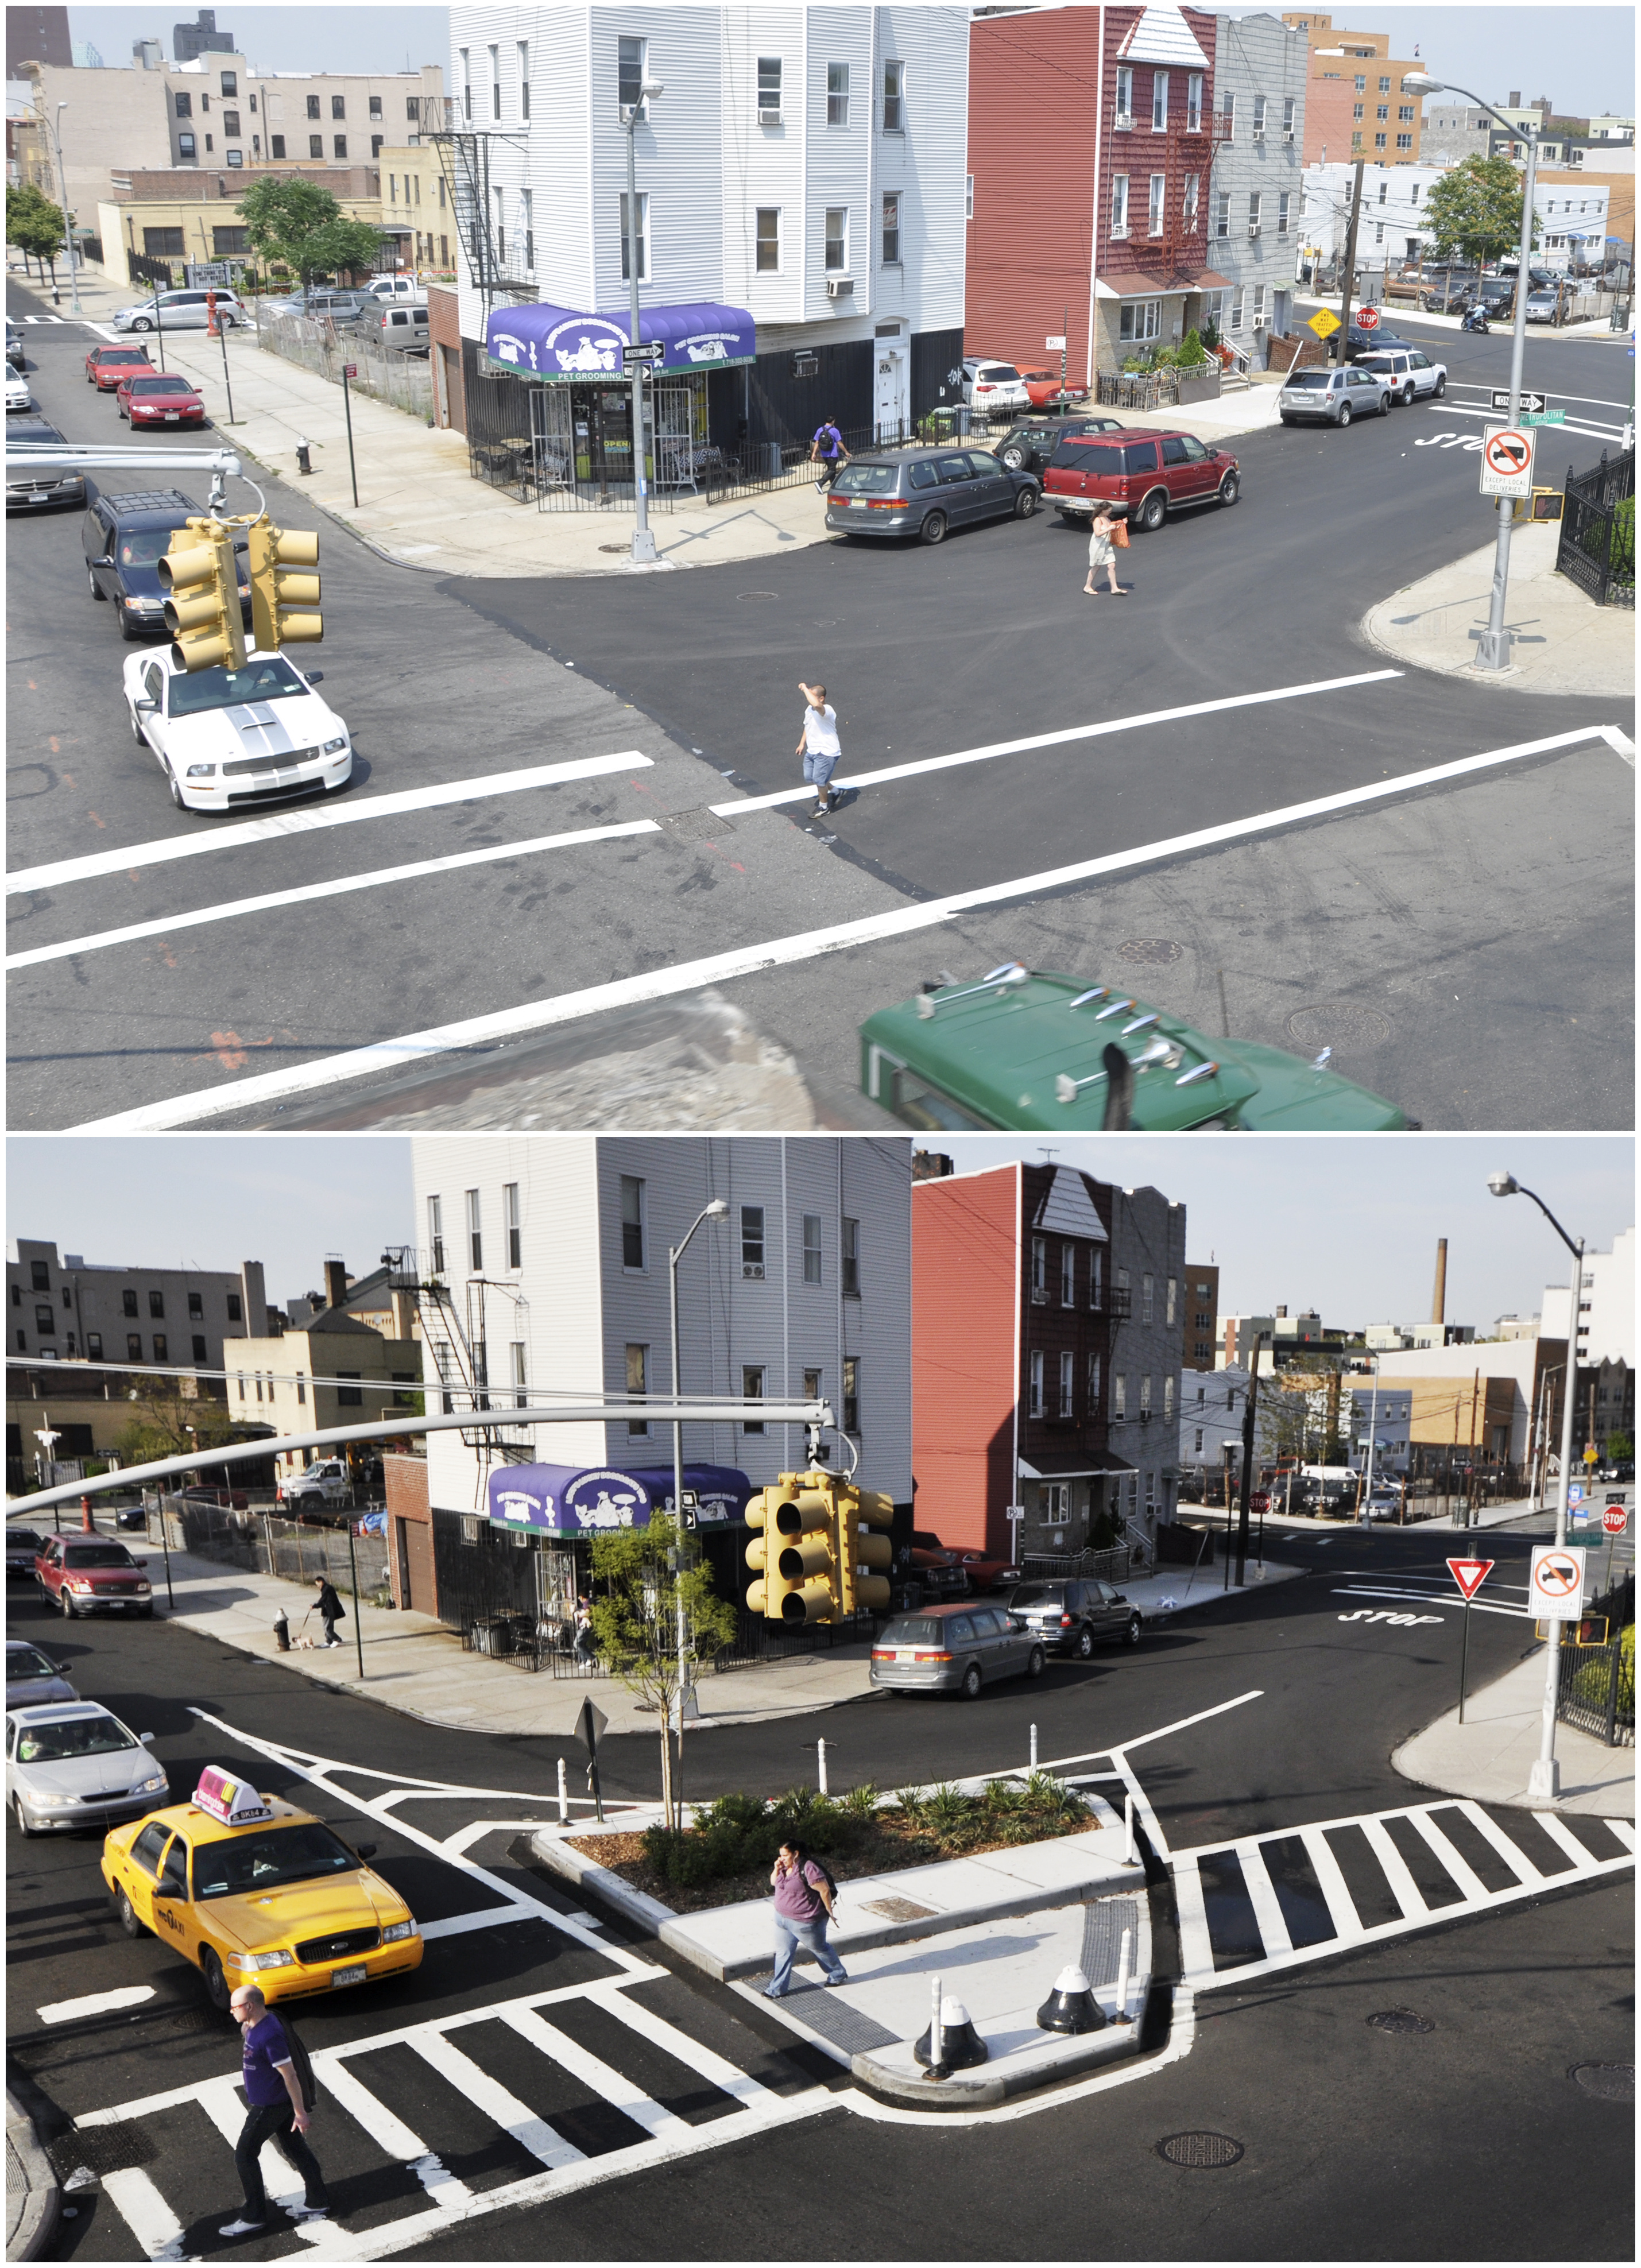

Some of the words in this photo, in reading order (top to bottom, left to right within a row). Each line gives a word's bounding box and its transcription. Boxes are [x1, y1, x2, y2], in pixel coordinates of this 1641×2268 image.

[1357, 314, 1377, 323] STOP
[674, 339, 686, 351] PET
[687, 333, 719, 345] GROOMING
[719, 333, 740, 342] SALON
[1499, 397, 1510, 405] ON
[1522, 399, 1538, 407] WAY
[1520, 411, 1563, 421] METROPOLITAN
[1414, 433, 1483, 452] STO
[1489, 484, 1521, 493] DELIVERIES
[1604, 1512, 1625, 1526] STOP
[577, 1529, 592, 1537] PET
[1337, 1609, 1445, 1627] STOP
